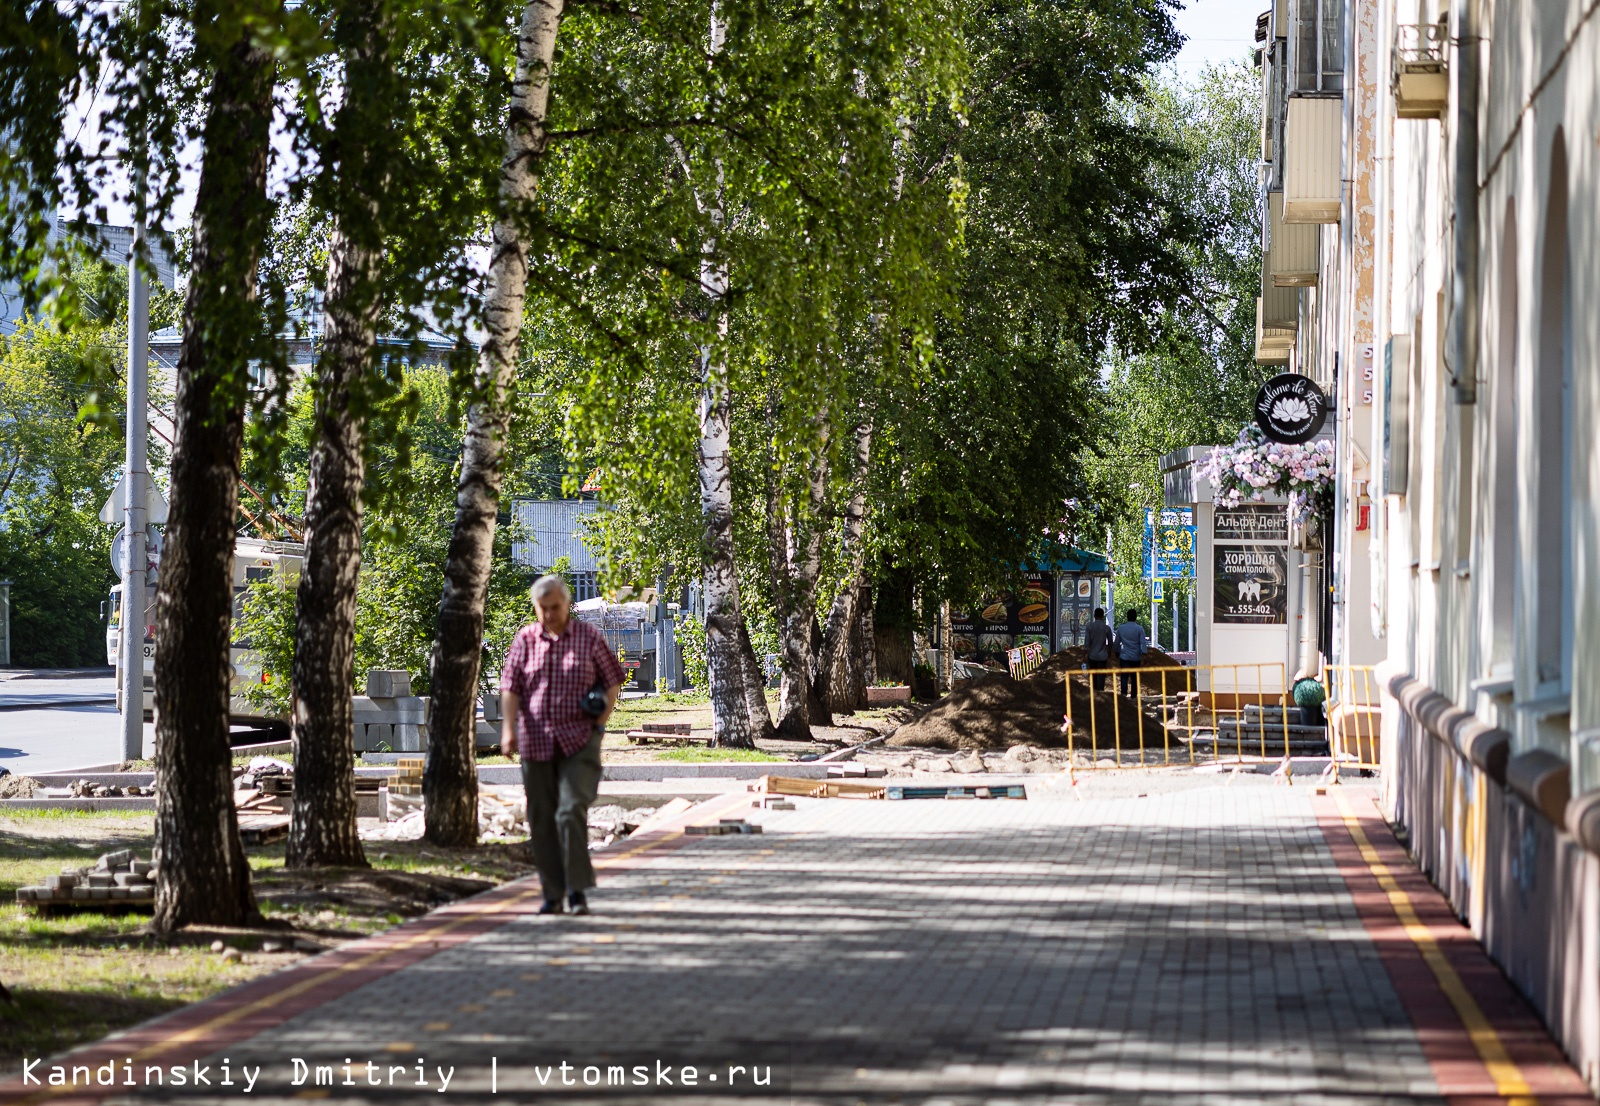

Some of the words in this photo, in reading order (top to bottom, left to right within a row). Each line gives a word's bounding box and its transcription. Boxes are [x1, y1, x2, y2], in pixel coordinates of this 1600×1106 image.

[1258, 384, 1291, 416] Madame
[1291, 379, 1307, 394] de
[1304, 390, 1323, 417] Fleur
[1352, 479, 1371, 498] Т
[1217, 516, 1256, 529] Альфа
[1258, 516, 1286, 529] Дент
[1225, 553, 1276, 565] ХОРОШАЯ
[1225, 565, 1276, 574] СТОМАТОЛОГИЯ
[1238, 605, 1271, 614] 555-402
